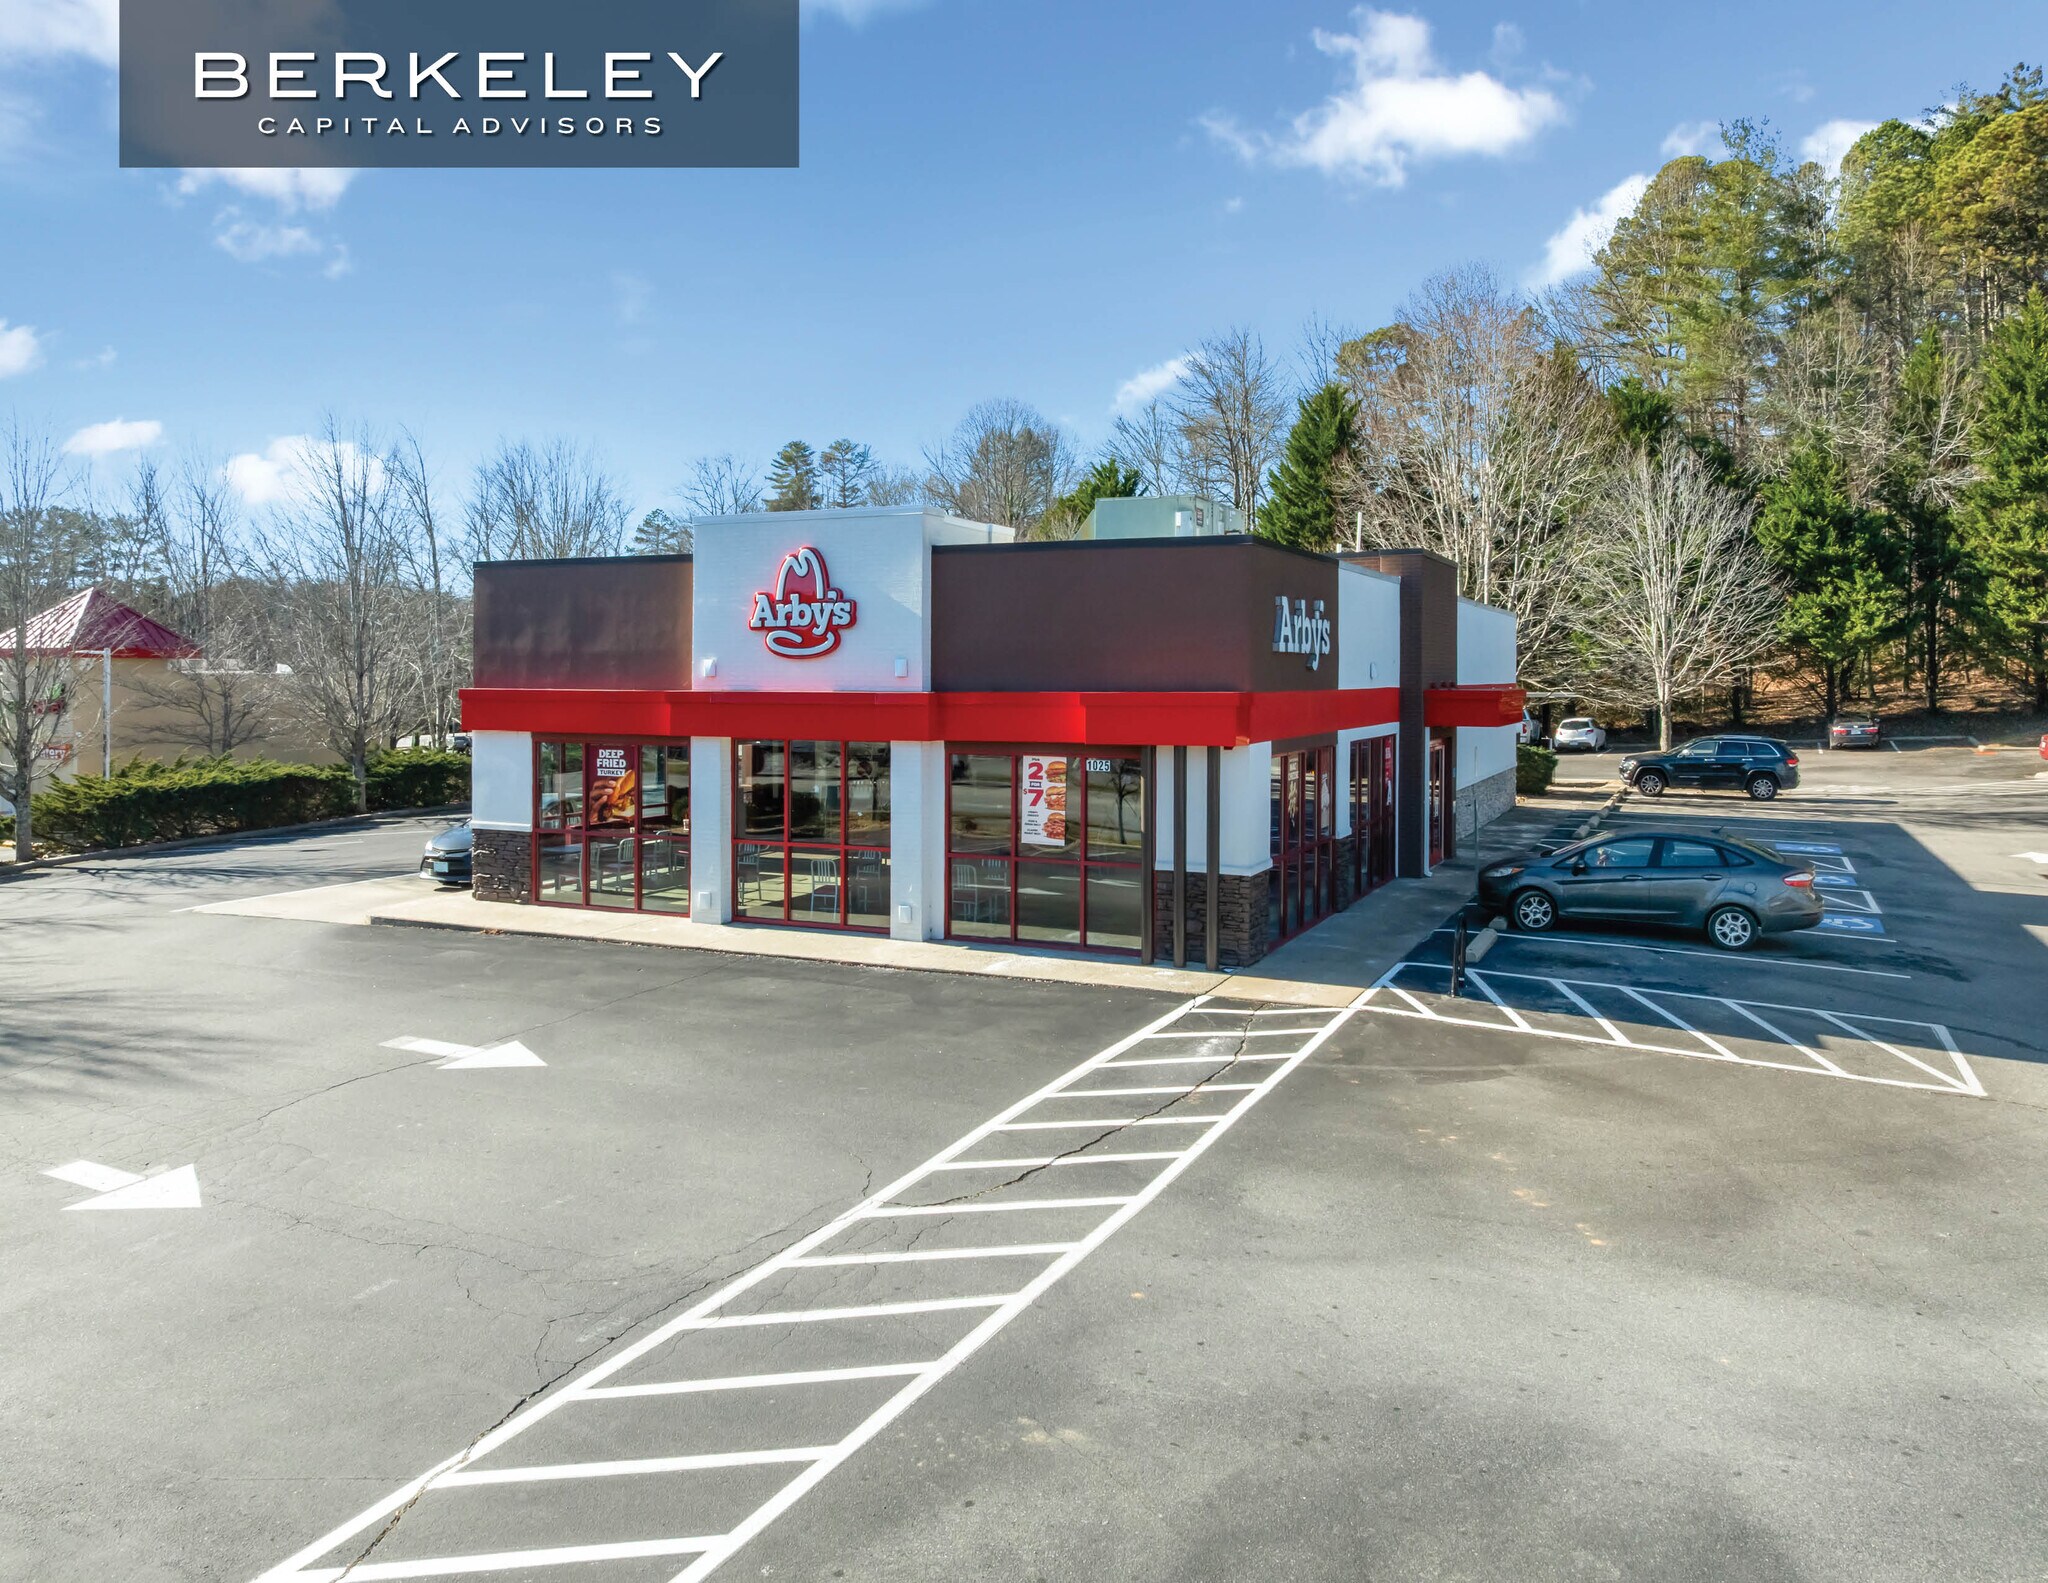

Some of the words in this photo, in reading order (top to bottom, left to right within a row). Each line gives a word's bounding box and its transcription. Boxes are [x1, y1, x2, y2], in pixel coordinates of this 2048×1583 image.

[750, 590, 851, 635] Arby's
[1273, 595, 1331, 671] Arby's
[598, 749, 625, 758] DEEP
[596, 759, 627, 768] FRIED
[1087, 760, 1110, 771] 1025
[1028, 762, 1044, 780] 2
